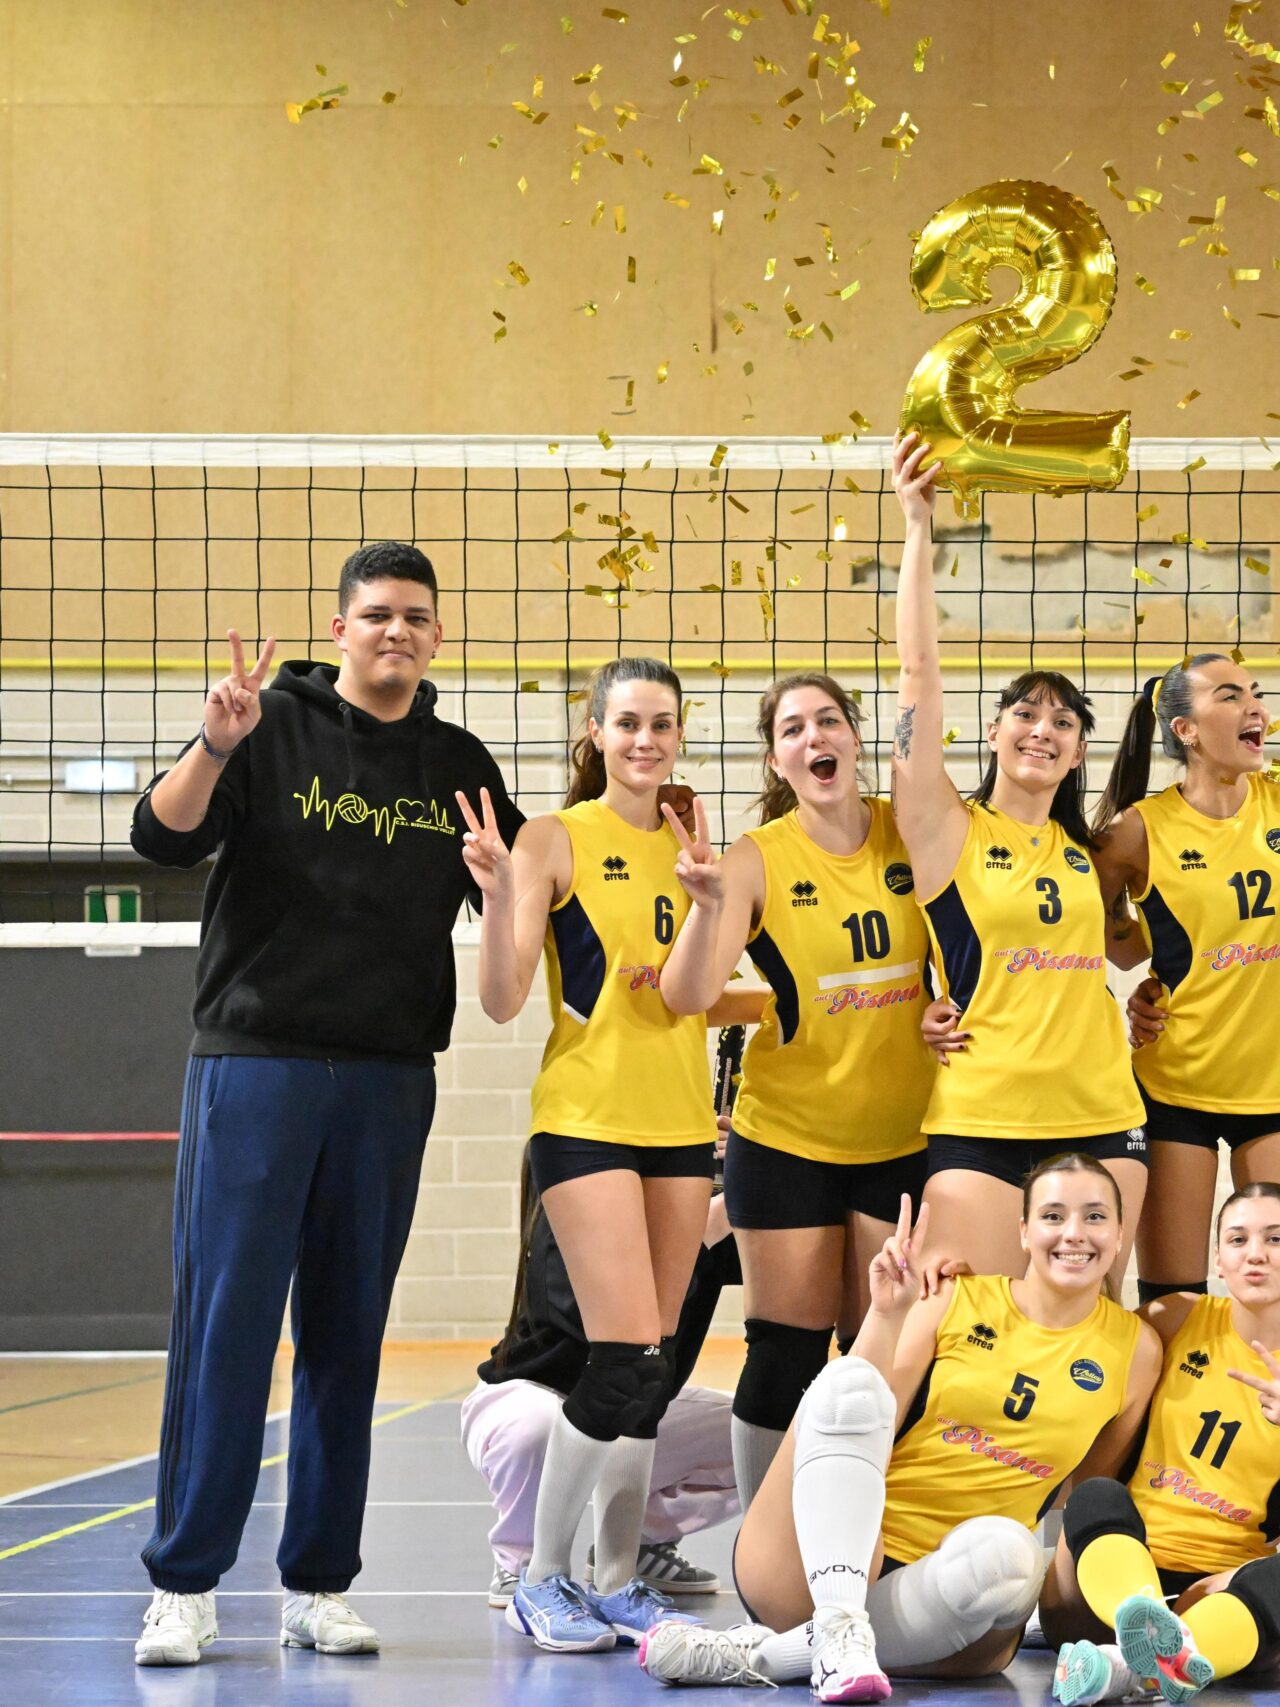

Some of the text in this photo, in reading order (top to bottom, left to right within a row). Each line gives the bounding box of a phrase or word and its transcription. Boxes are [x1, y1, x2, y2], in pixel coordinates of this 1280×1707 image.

[898, 179, 1131, 496] 2
[604, 872, 630, 881] errea
[985, 861, 1012, 870] errea
[1181, 862, 1207, 871] errea
[792, 897, 818, 907] errea
[1035, 877, 1062, 924] 3
[1227, 869, 1276, 920] 12
[654, 895, 674, 945] 6
[842, 910, 891, 962] 10
[1007, 947, 1104, 973] Pisana
[827, 983, 920, 1015] Pisana
[1126, 1141, 1146, 1151] errea
[967, 1333, 994, 1351] errea
[1179, 1362, 1203, 1380] errea
[1002, 1372, 1040, 1422] 5
[942, 1425, 1054, 1479] Pisana
[1189, 1409, 1242, 1470] 11
[1150, 1467, 1252, 1522] Pisana
